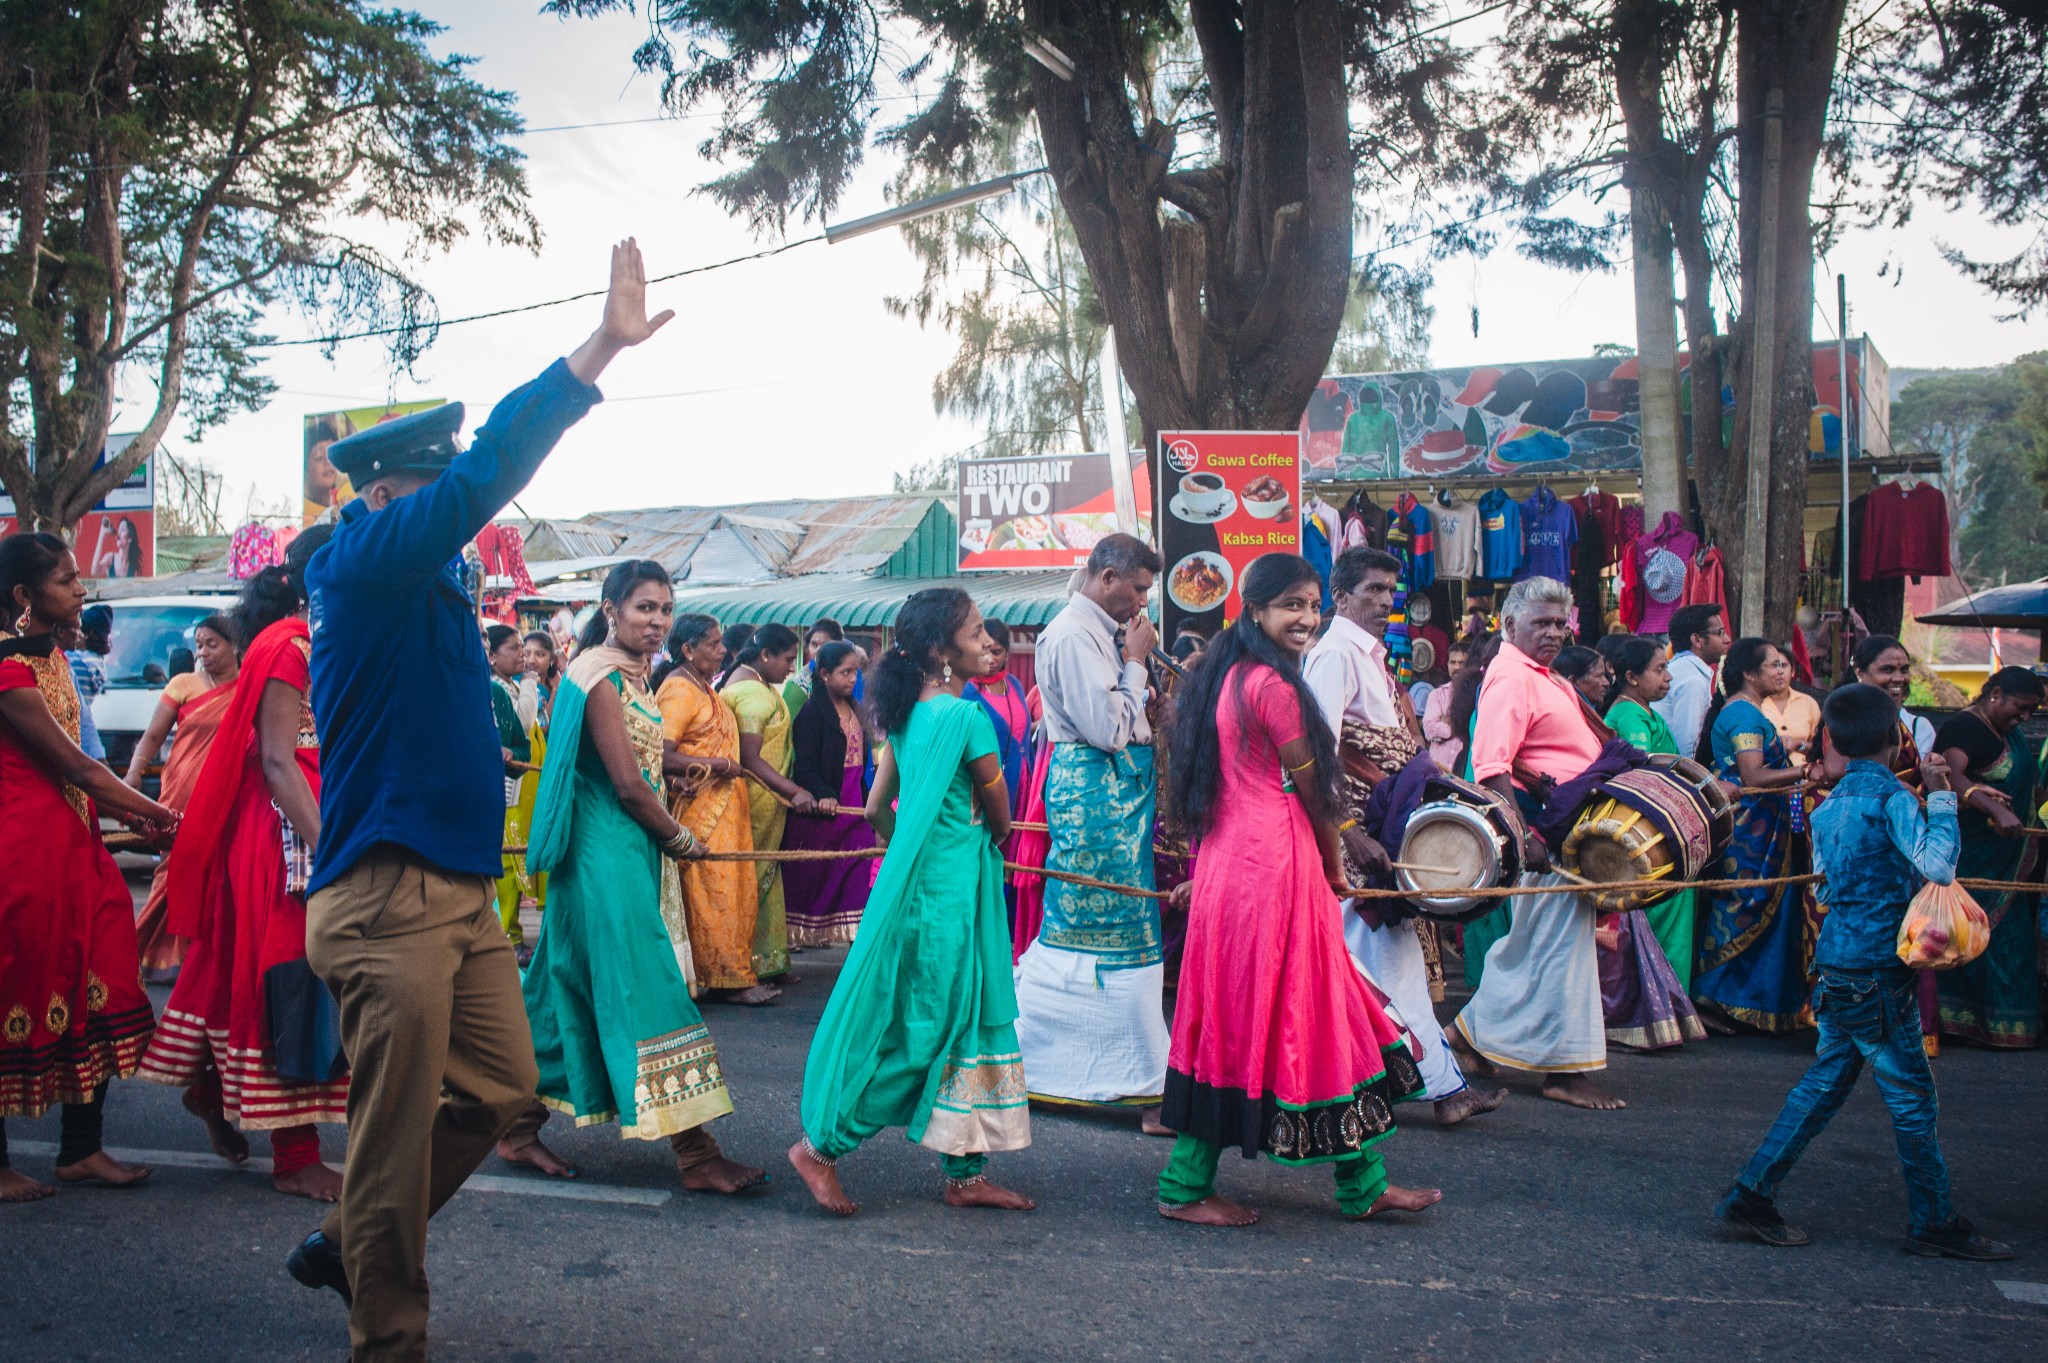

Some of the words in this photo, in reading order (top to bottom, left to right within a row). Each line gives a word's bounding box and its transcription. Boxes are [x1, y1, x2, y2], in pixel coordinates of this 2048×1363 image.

[1206, 453, 1246, 467] Gawa
[1250, 452, 1294, 467] Coffee
[966, 460, 1073, 486] RESTAURANT
[963, 483, 1050, 517] TWO
[1223, 532, 1264, 546] Kabsa
[1267, 532, 1296, 545] Rice
